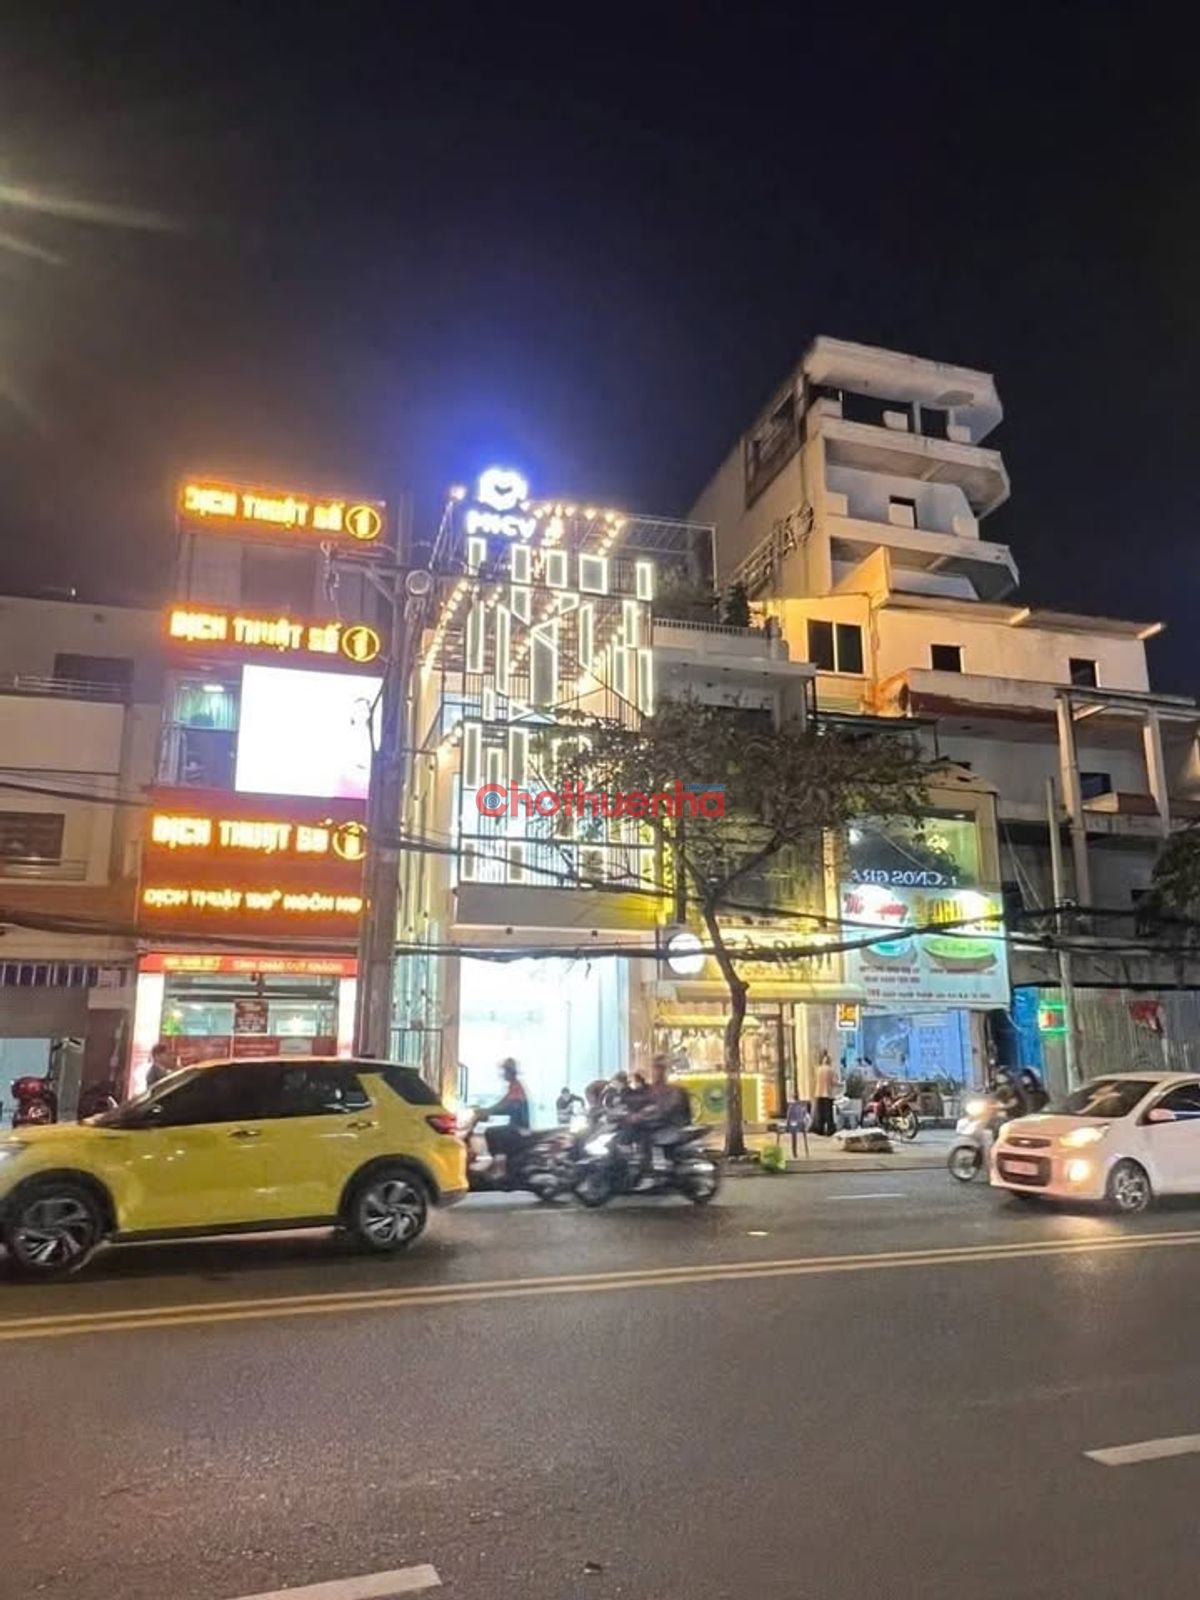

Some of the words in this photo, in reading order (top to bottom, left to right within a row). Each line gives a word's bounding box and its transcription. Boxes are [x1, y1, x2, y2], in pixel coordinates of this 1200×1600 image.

[243, 494, 309, 528] THUẬT
[170, 611, 227, 641] DỊCH
[233, 617, 303, 652] THUẬT
[152, 815, 211, 849] DỊCH
